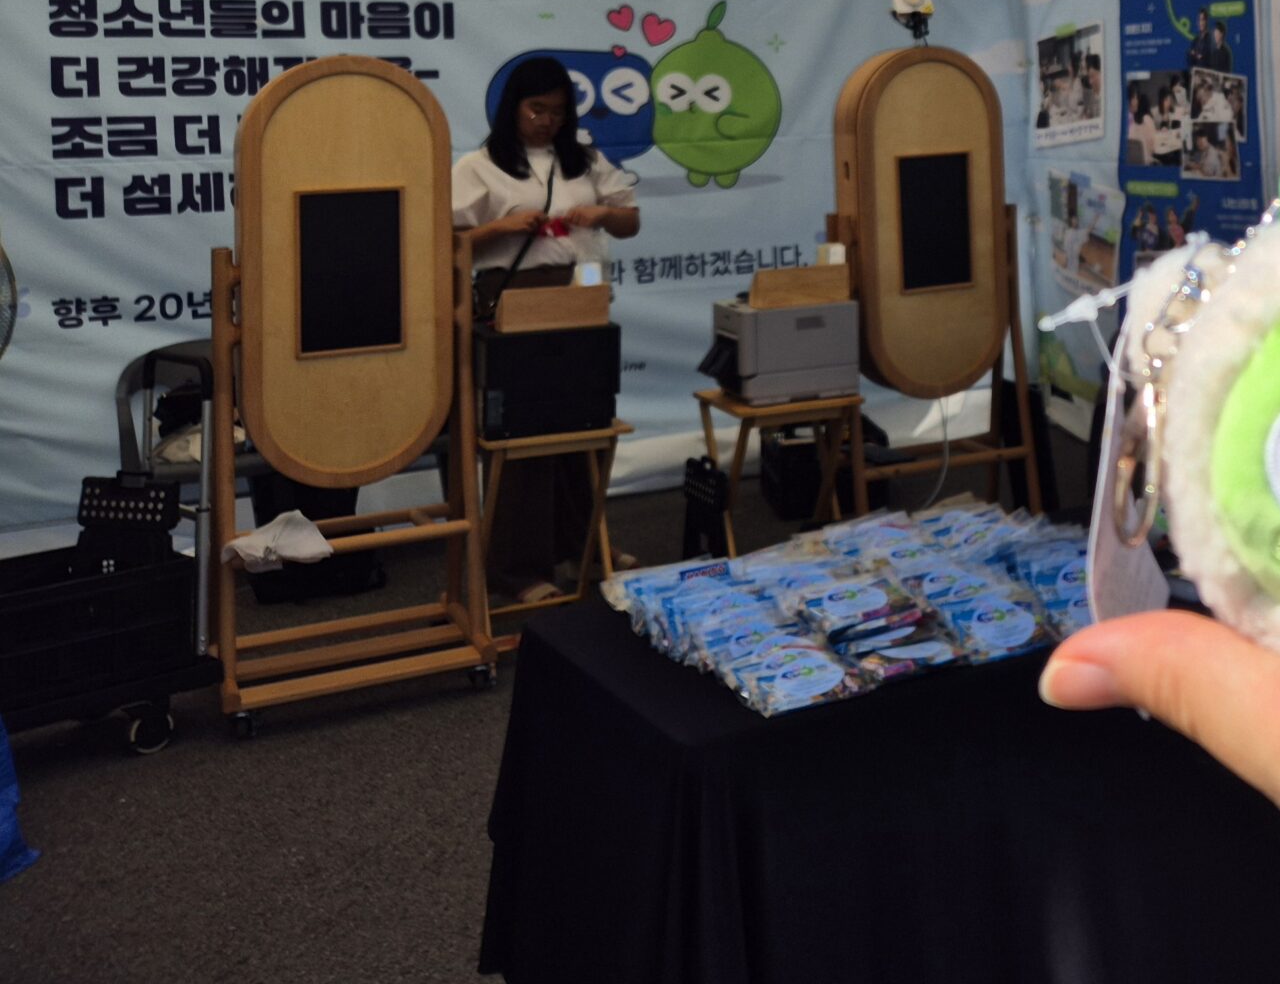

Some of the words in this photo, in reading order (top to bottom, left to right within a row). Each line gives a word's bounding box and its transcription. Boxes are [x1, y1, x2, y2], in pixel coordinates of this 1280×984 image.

[320, 0, 455, 41] 마음이
[50, 55, 101, 99] 더
[51, 115, 159, 160] 조금
[173, 113, 223, 157] 더
[54, 175, 106, 221] 더
[122, 171, 236, 218] 섬세
[633, 244, 809, 284] 함께하겠습니다.
[51, 295, 123, 331] 향후
